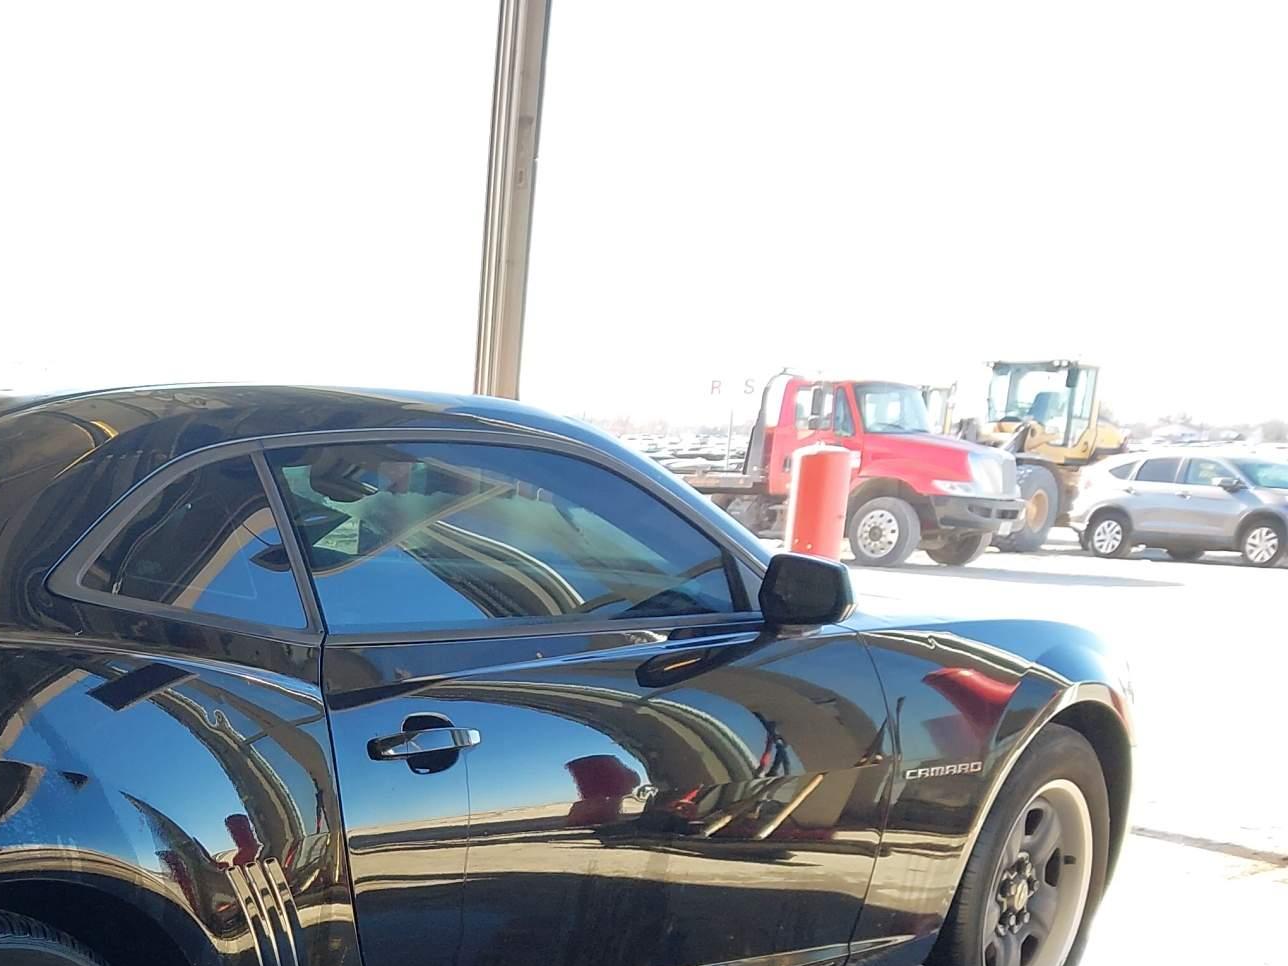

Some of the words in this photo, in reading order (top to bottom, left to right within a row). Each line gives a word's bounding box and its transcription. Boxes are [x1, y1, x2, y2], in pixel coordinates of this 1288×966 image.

[710, 379, 722, 395] R
[743, 378, 755, 395] S
[905, 761, 982, 780] CAMARO
